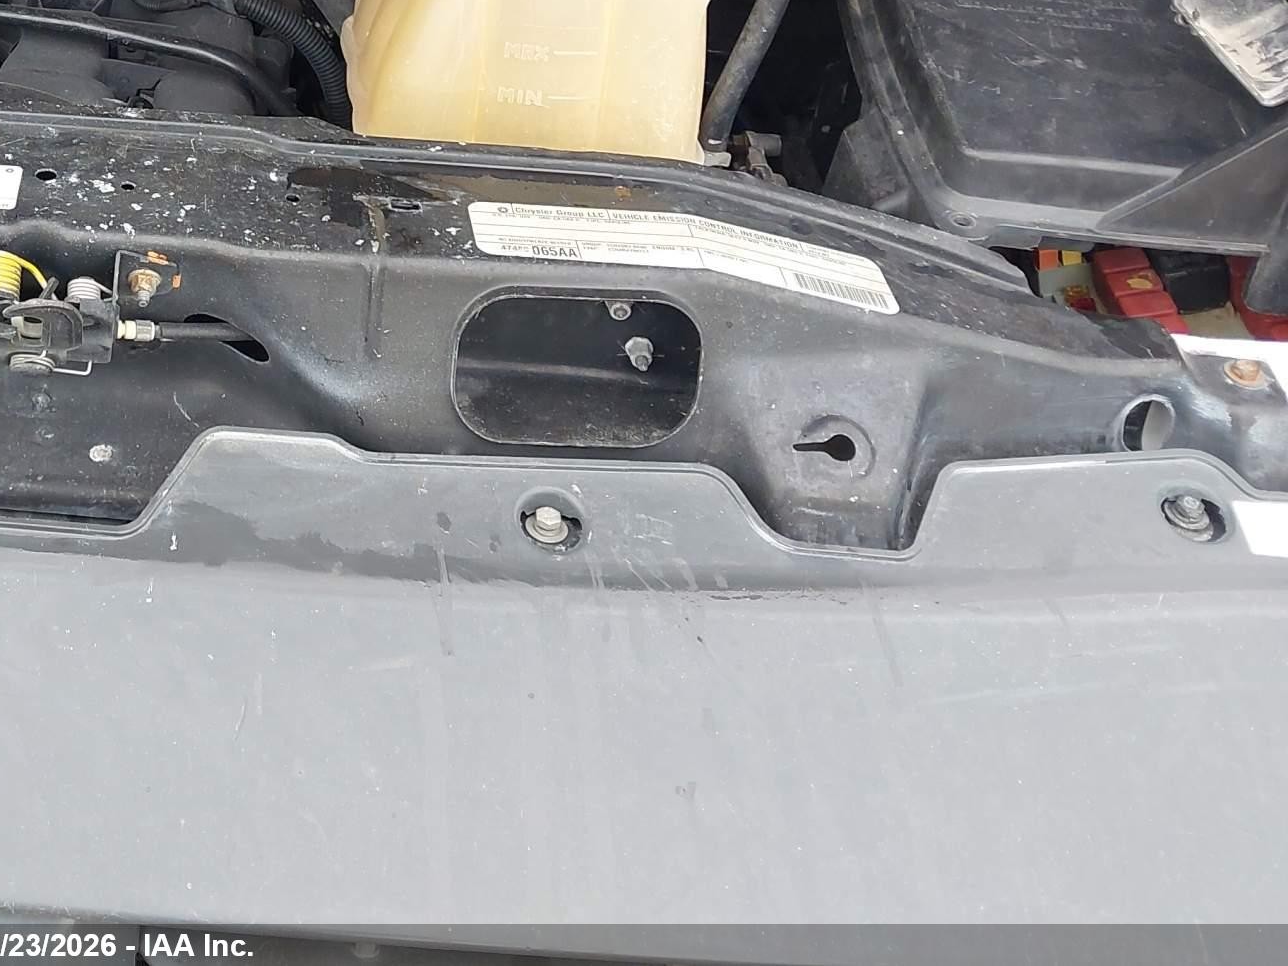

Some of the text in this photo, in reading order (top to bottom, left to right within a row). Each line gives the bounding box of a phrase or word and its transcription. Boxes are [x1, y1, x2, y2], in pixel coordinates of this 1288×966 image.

[496, 85, 543, 107] MIN
[515, 207, 553, 216] Chrysler
[556, 209, 584, 218] Group
[587, 210, 605, 218] LLC
[613, 212, 649, 221] VEHICLE
[653, 214, 696, 224] EMISSION
[698, 219, 737, 235] CONTROL
[740, 230, 798, 249] INFORMATION
[532, 245, 578, 258] 065AA
